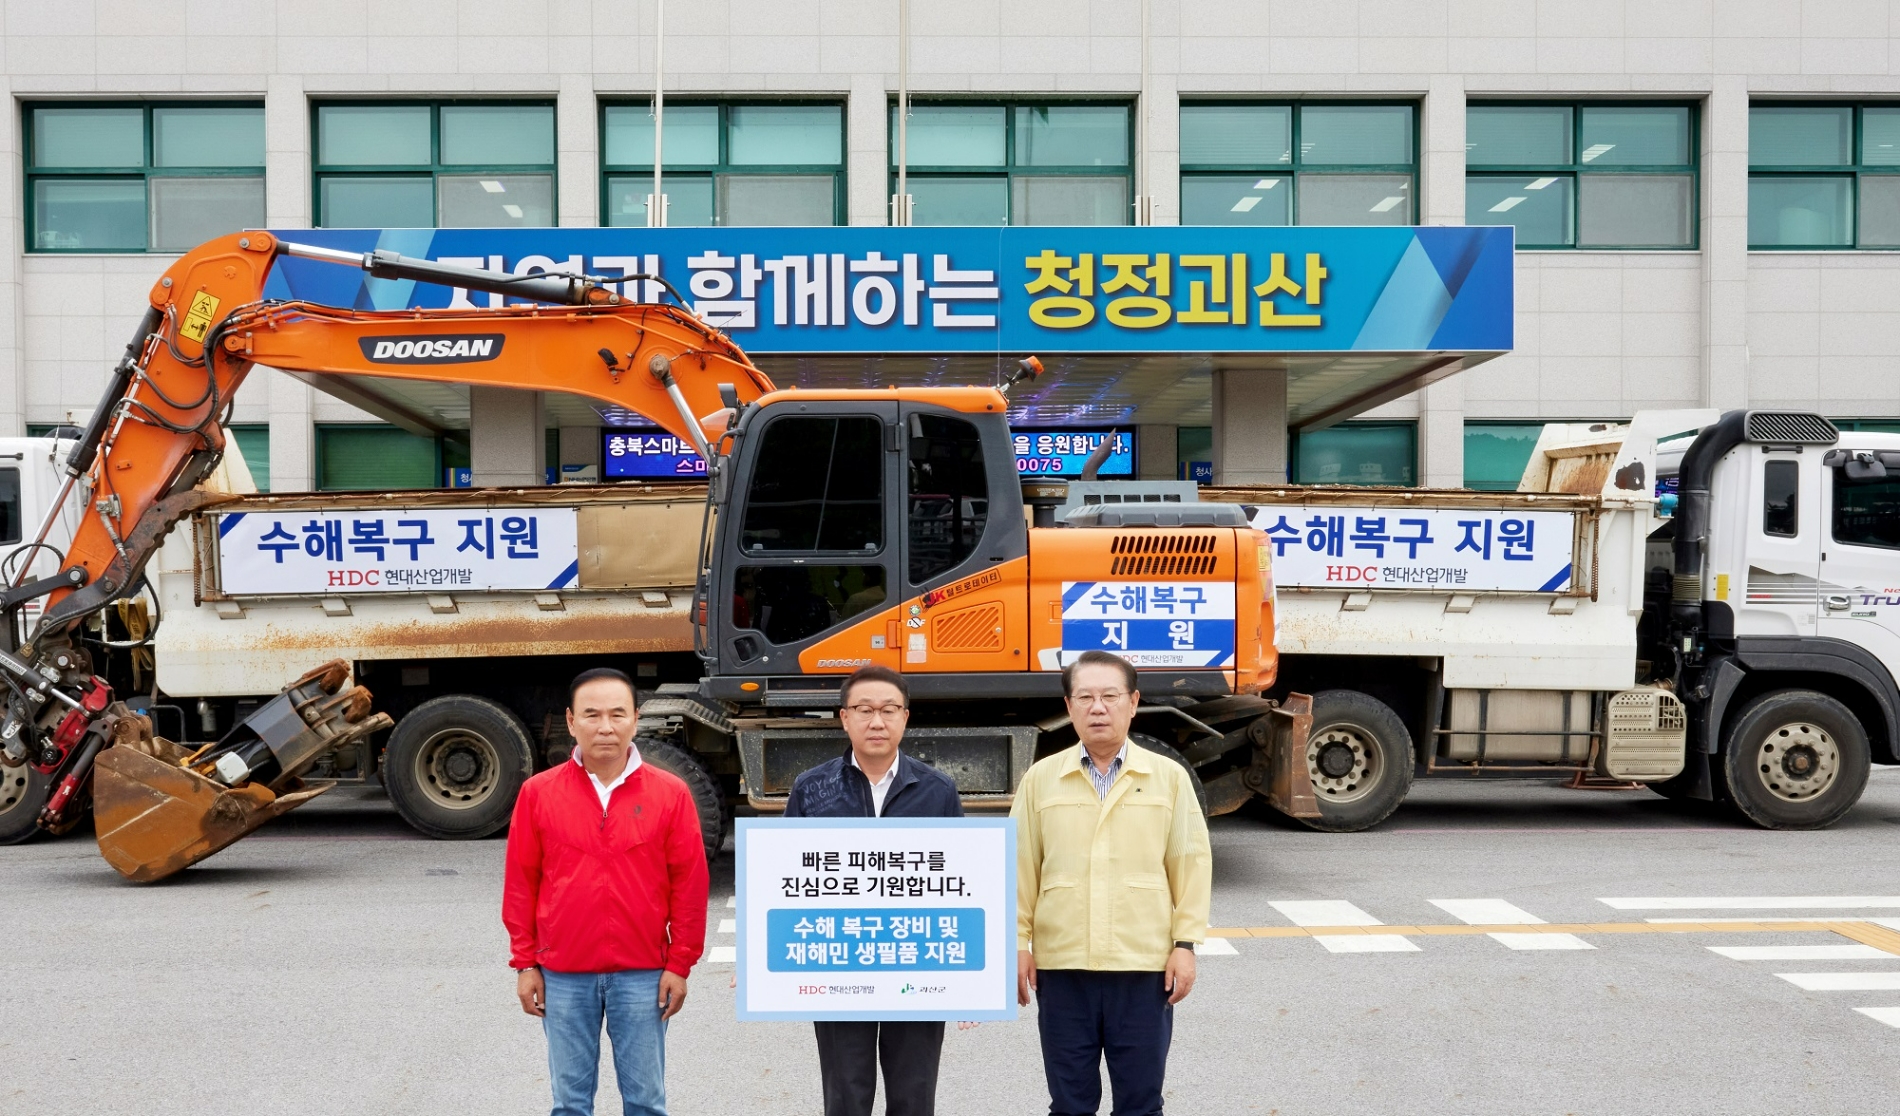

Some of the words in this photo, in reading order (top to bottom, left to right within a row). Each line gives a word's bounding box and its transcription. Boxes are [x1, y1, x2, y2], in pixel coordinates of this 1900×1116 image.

[687, 250, 999, 329] 함께하는
[1024, 249, 1330, 329] 청정괴산
[372, 339, 494, 359] DOOSAN
[460, 473, 472, 484] 청
[257, 519, 435, 564] 수해복구
[456, 516, 540, 560] 지원
[1264, 514, 1435, 560] 수해복구
[1453, 518, 1535, 562] 지원
[327, 570, 380, 587] HDC
[384, 567, 473, 586] 현대산업개발
[1326, 565, 1378, 583] HDC
[1382, 566, 1469, 584] 현대산업개발
[1090, 585, 1207, 615] 수해복구
[816, 658, 872, 668] DOOSAN
[1120, 654, 1139, 664] DC
[1140, 654, 1184, 664] 현대산업개발
[802, 851, 842, 872] 빠른
[847, 851, 947, 872] 피해복구를
[781, 876, 860, 898] 진심으로
[866, 876, 972, 898] 기원합니다.
[793, 916, 836, 939] 수해
[841, 916, 884, 939] 복구
[888, 915, 931, 939] 장비
[937, 916, 959, 939] 및
[785, 942, 849, 965] 재해민
[854, 942, 919, 965] 생필품
[924, 941, 967, 965] 지원
[798, 985, 827, 995] HDC
[828, 985, 875, 995] 현대산업개발
